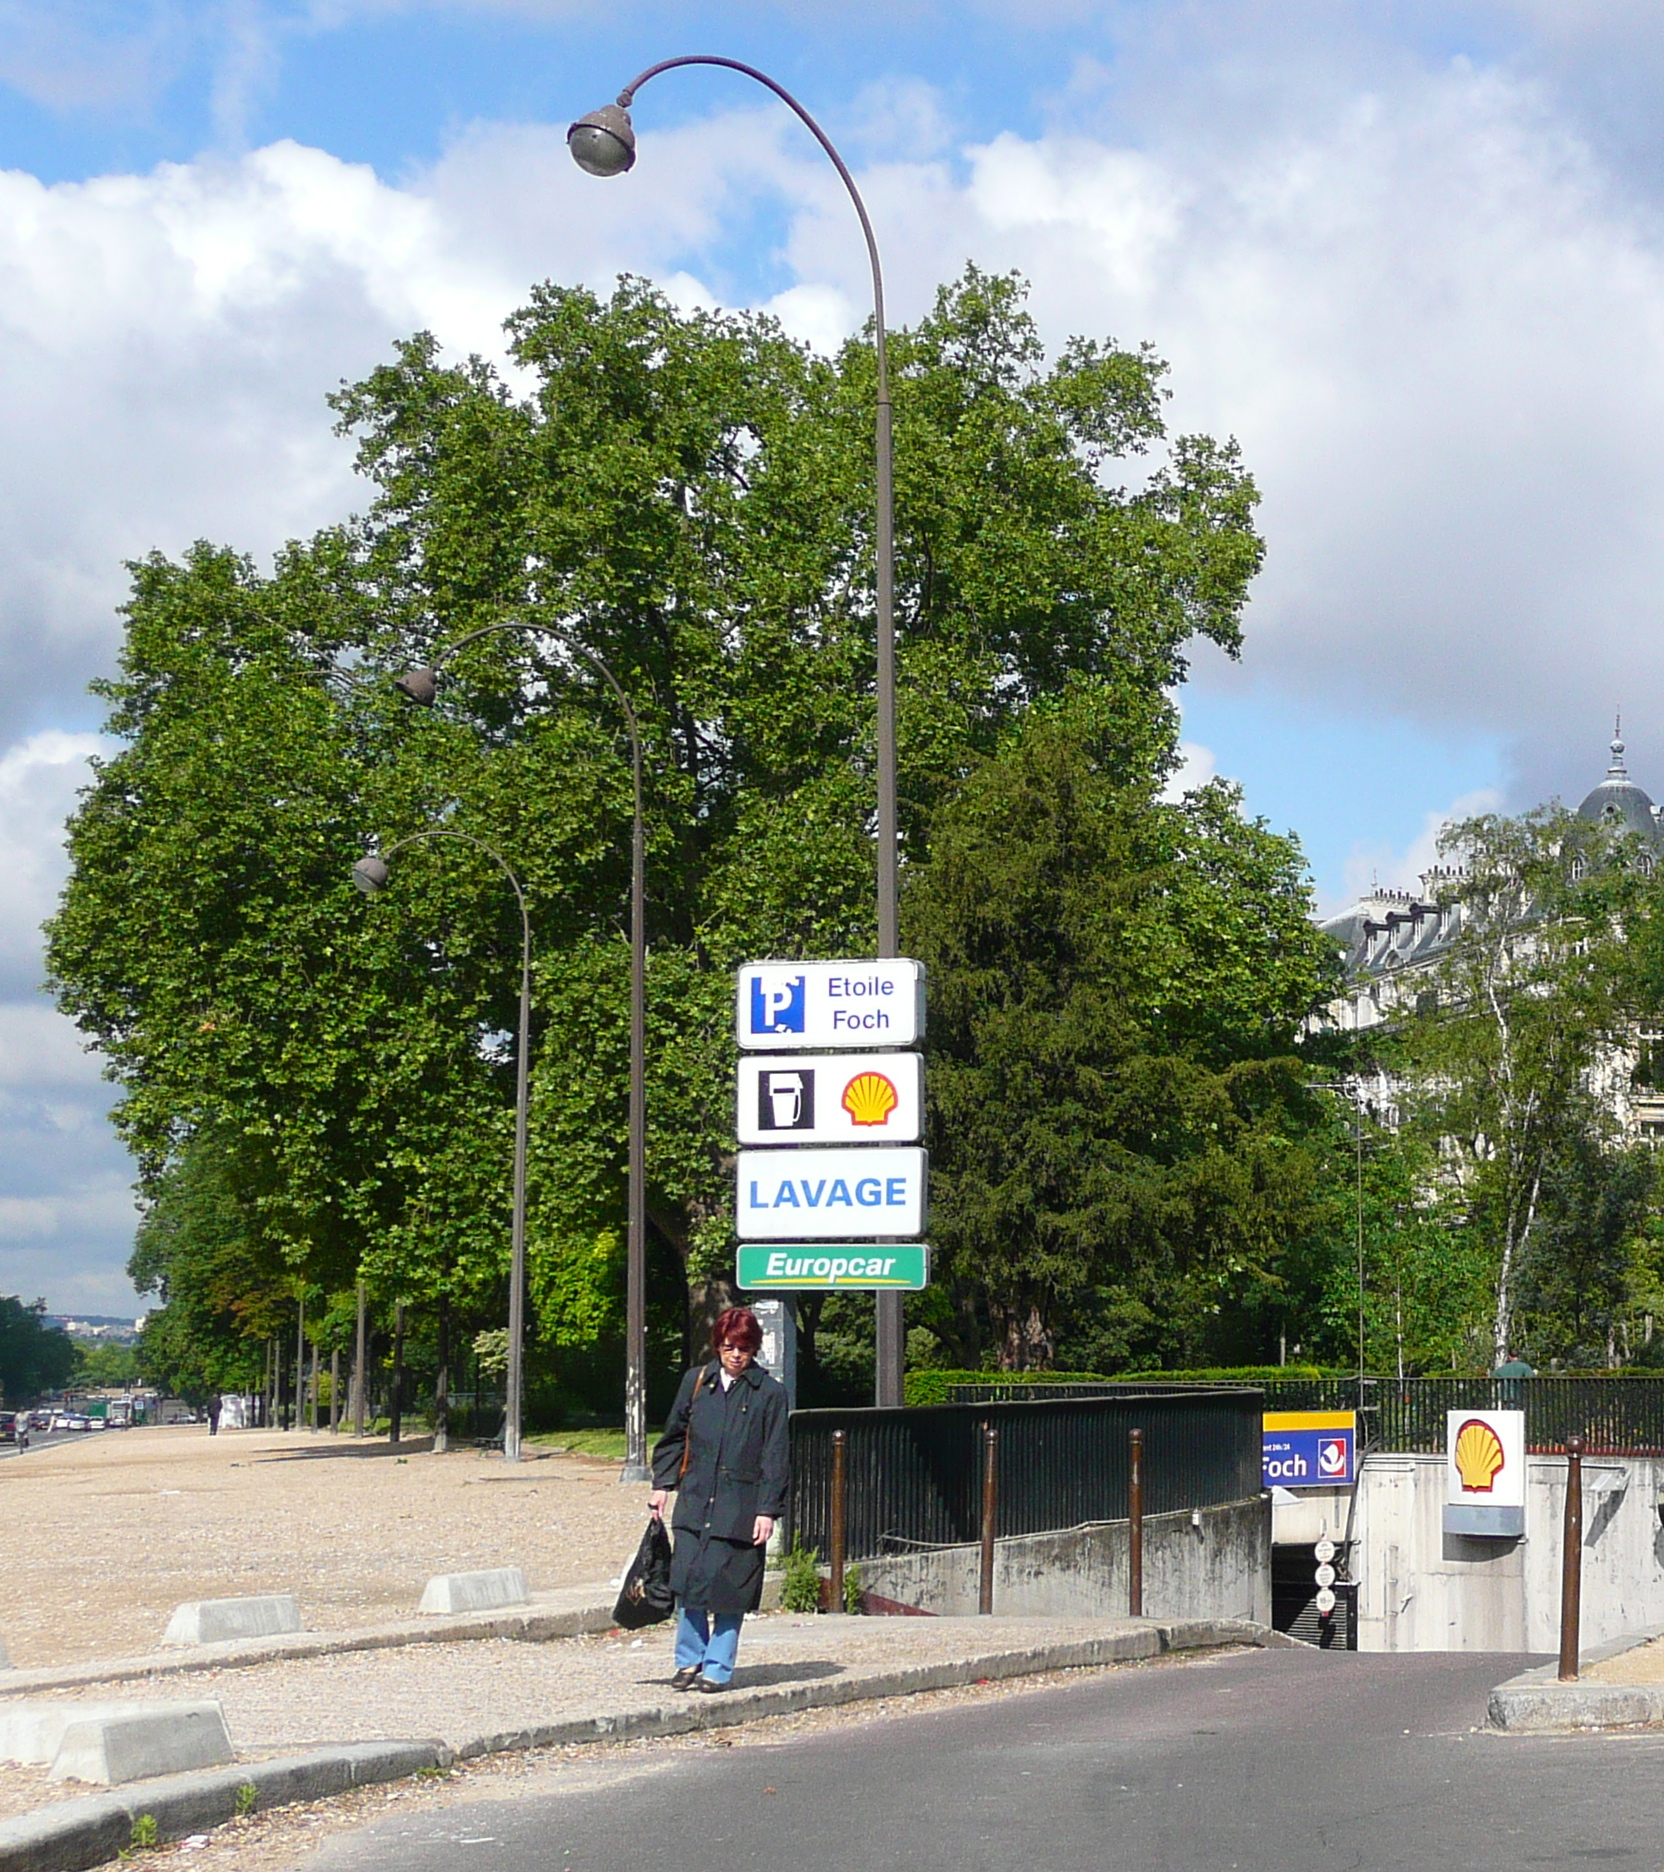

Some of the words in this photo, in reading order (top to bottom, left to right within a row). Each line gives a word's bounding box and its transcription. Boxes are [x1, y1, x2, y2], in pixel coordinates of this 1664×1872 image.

[828, 977, 894, 997] Etoile
[834, 1010, 889, 1029] Foch
[750, 1178, 907, 1209] LAVAGE
[766, 1254, 896, 1282] Europcar
